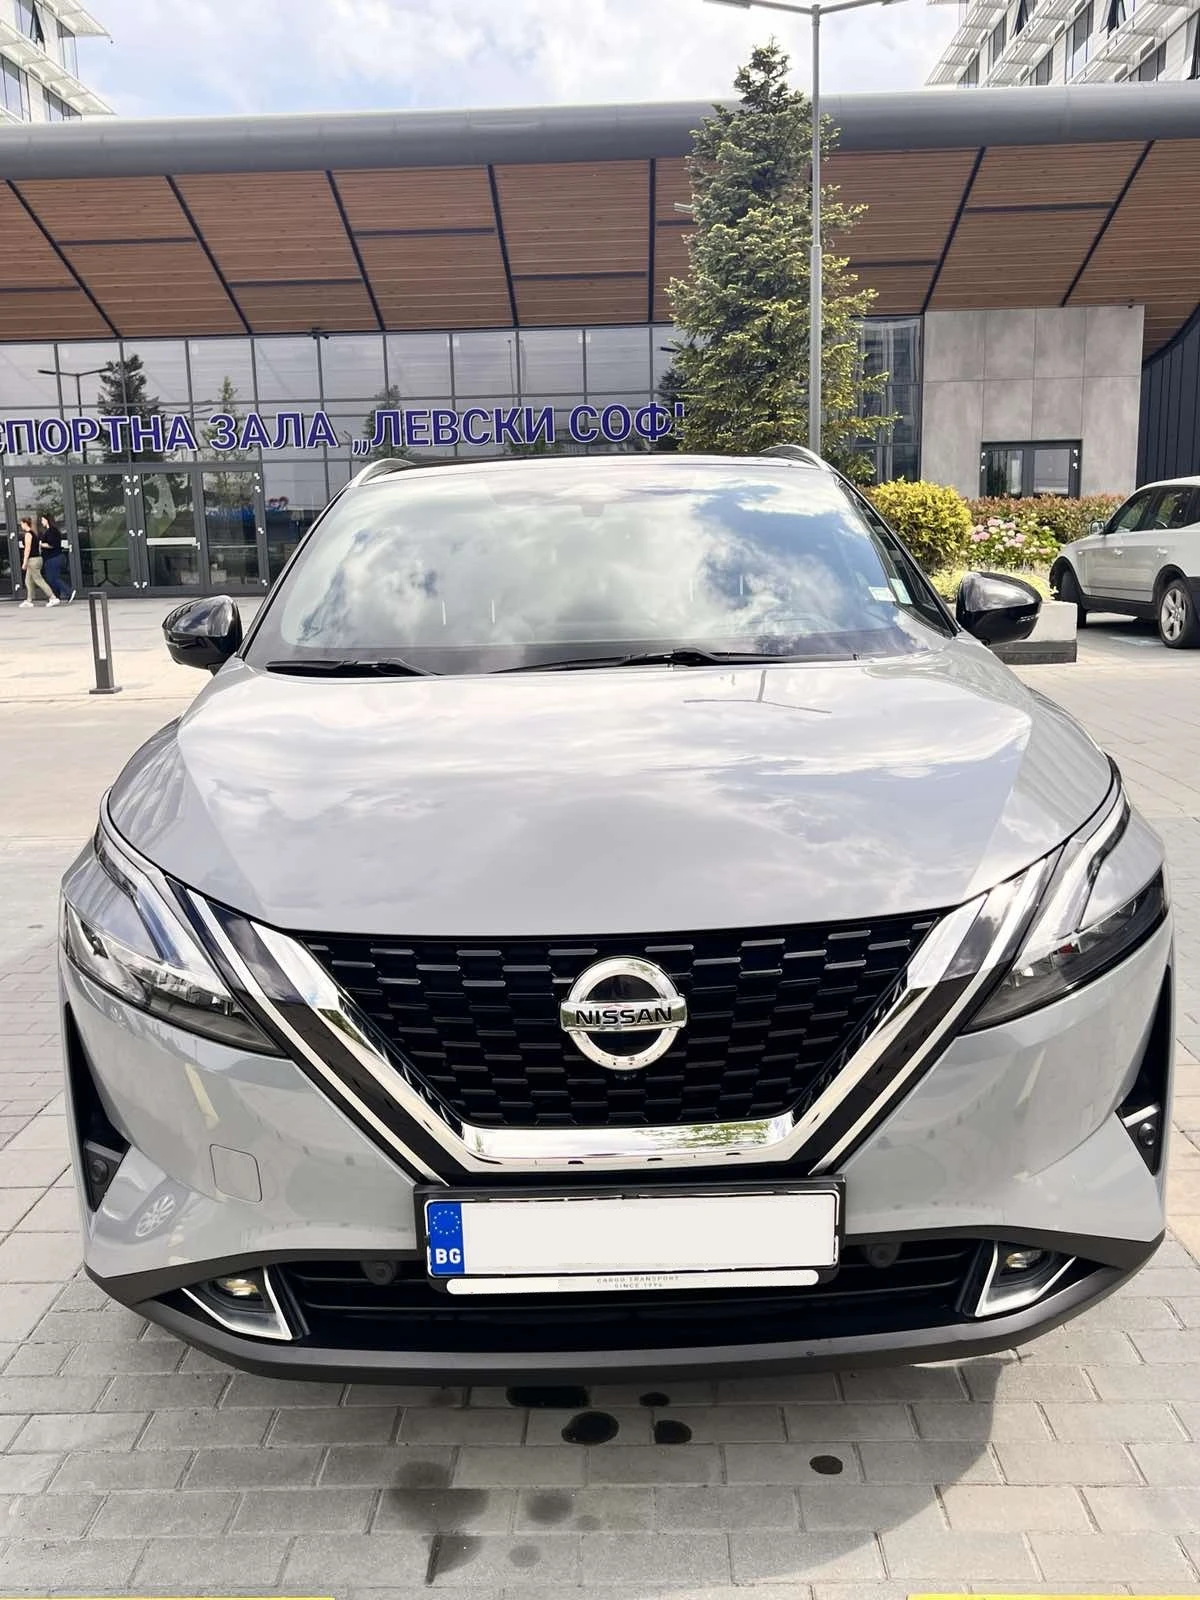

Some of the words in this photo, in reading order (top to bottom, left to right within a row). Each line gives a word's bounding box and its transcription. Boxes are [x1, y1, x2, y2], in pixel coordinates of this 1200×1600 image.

[0, 415, 198, 456] ПОРТНА
[209, 411, 338, 451] ЗАЛА
[352, 405, 555, 455] „ЛЕВСКИ
[575, 1006, 673, 1025] NISSAN
[435, 1248, 461, 1265] BG
